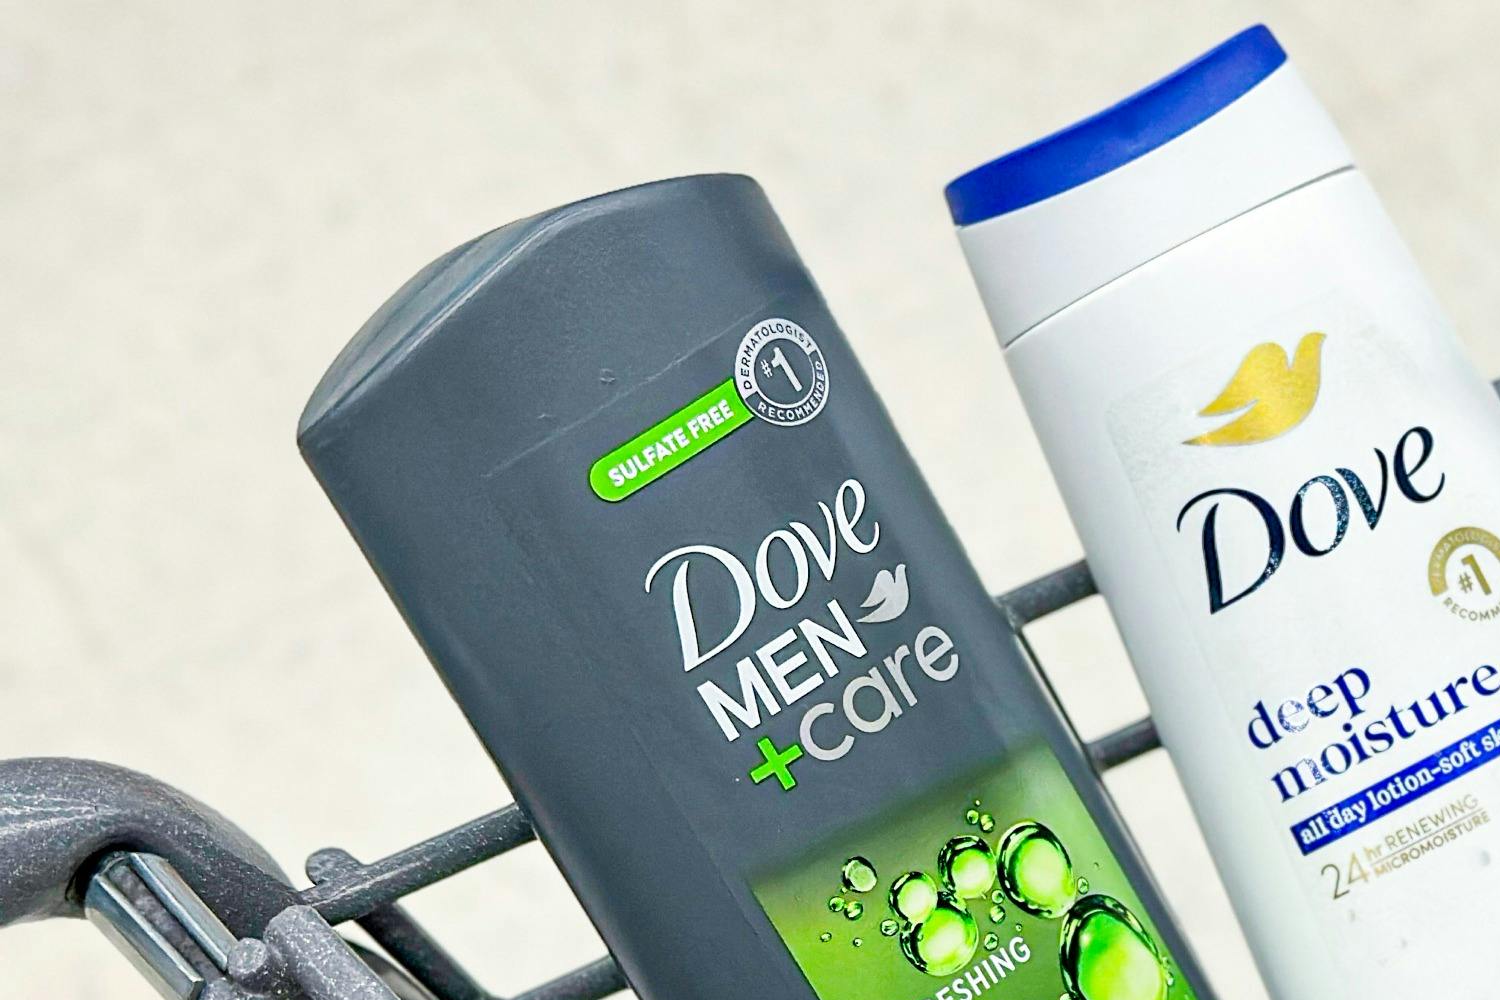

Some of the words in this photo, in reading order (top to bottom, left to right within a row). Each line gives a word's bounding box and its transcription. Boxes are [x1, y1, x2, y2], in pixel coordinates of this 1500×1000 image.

[741, 323, 812, 390] DERMATOLOGIST
[758, 361, 825, 420] RECOMMENDED
[761, 347, 802, 392] #1
[608, 428, 690, 488] SULFATE
[686, 399, 735, 437] FREE
[1177, 426, 1446, 616] Dove
[645, 479, 880, 672] Dove
[1458, 554, 1492, 595] #1
[697, 599, 868, 742] MEN
[1248, 666, 1371, 750] deep
[1300, 818, 1329, 845] all
[1328, 800, 1367, 831] day
[1366, 738, 1482, 810] lotion-soft
[1321, 853, 1370, 900] 24
[1364, 844, 1384, 861] hr
[1385, 794, 1480, 850] RENEWING
[1373, 811, 1491, 878] MICROMOISTURE
